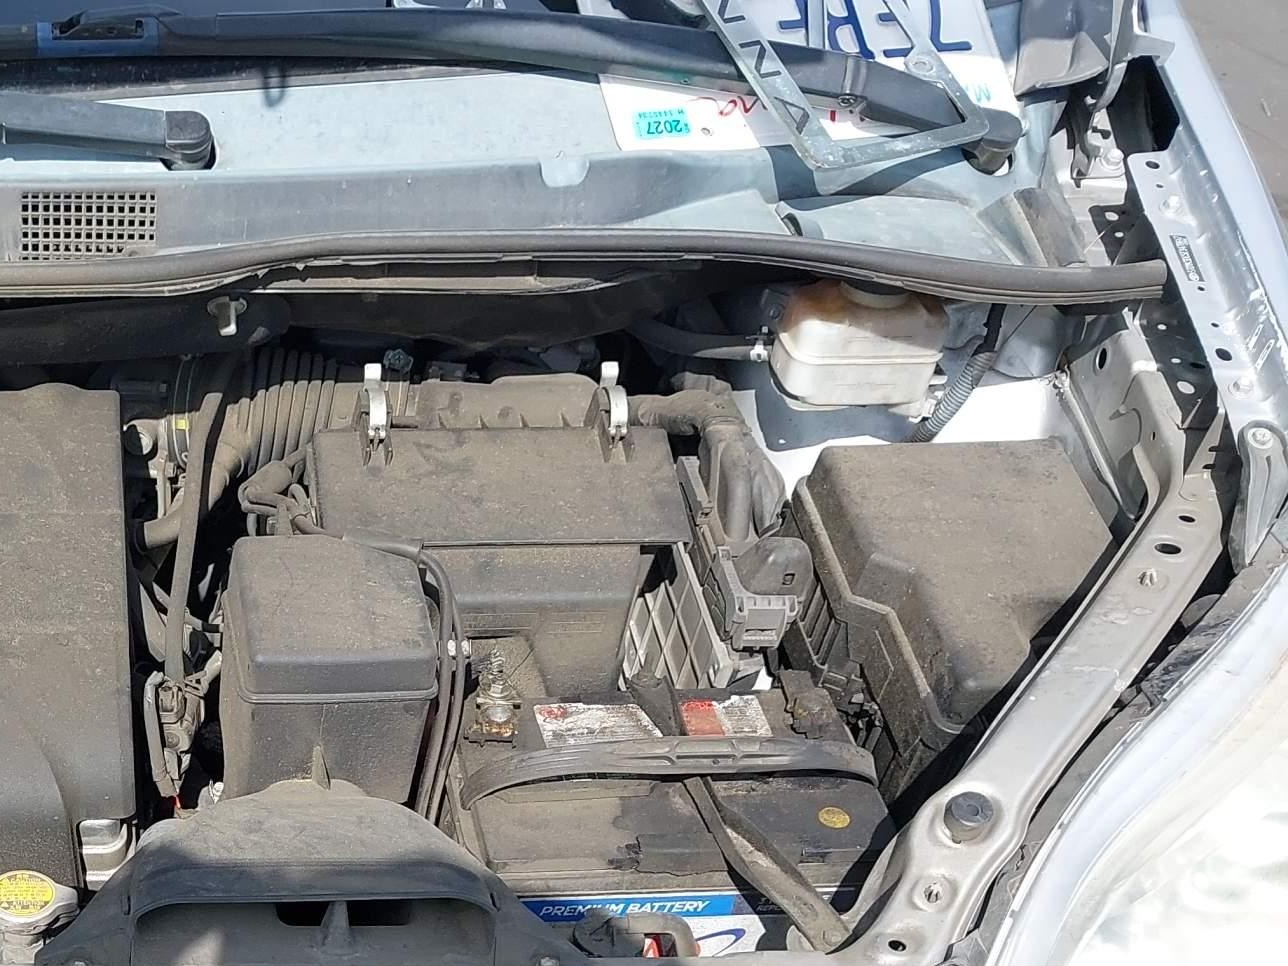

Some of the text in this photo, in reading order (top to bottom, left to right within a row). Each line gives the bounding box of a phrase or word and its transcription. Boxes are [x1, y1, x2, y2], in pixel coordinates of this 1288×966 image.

[647, 120, 683, 134] 2027
[540, 900, 711, 916] PREMM BATTERY
